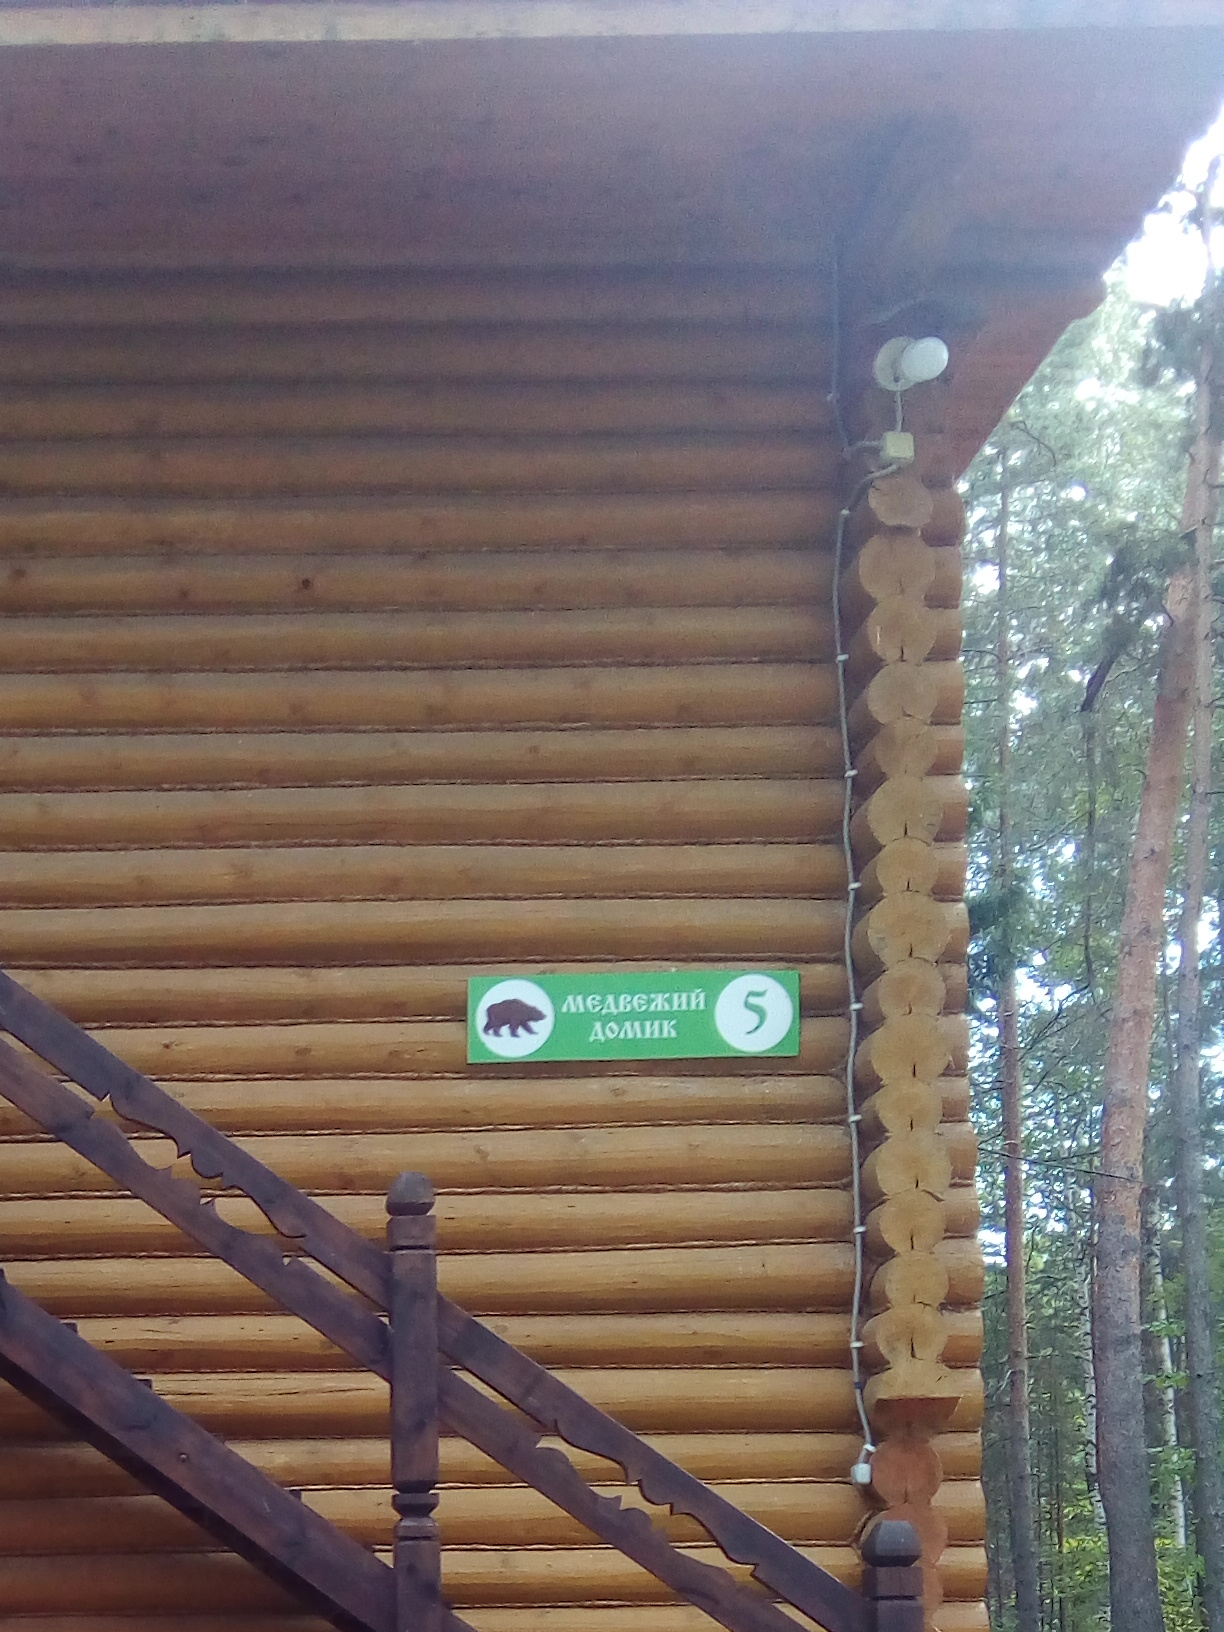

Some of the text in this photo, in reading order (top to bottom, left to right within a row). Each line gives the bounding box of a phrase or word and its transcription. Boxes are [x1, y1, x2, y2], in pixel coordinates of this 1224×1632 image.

[561, 988, 706, 1015] МЕДВЕЖИЙ
[743, 988, 768, 1035] 5
[588, 1018, 678, 1043] ДОМИК
